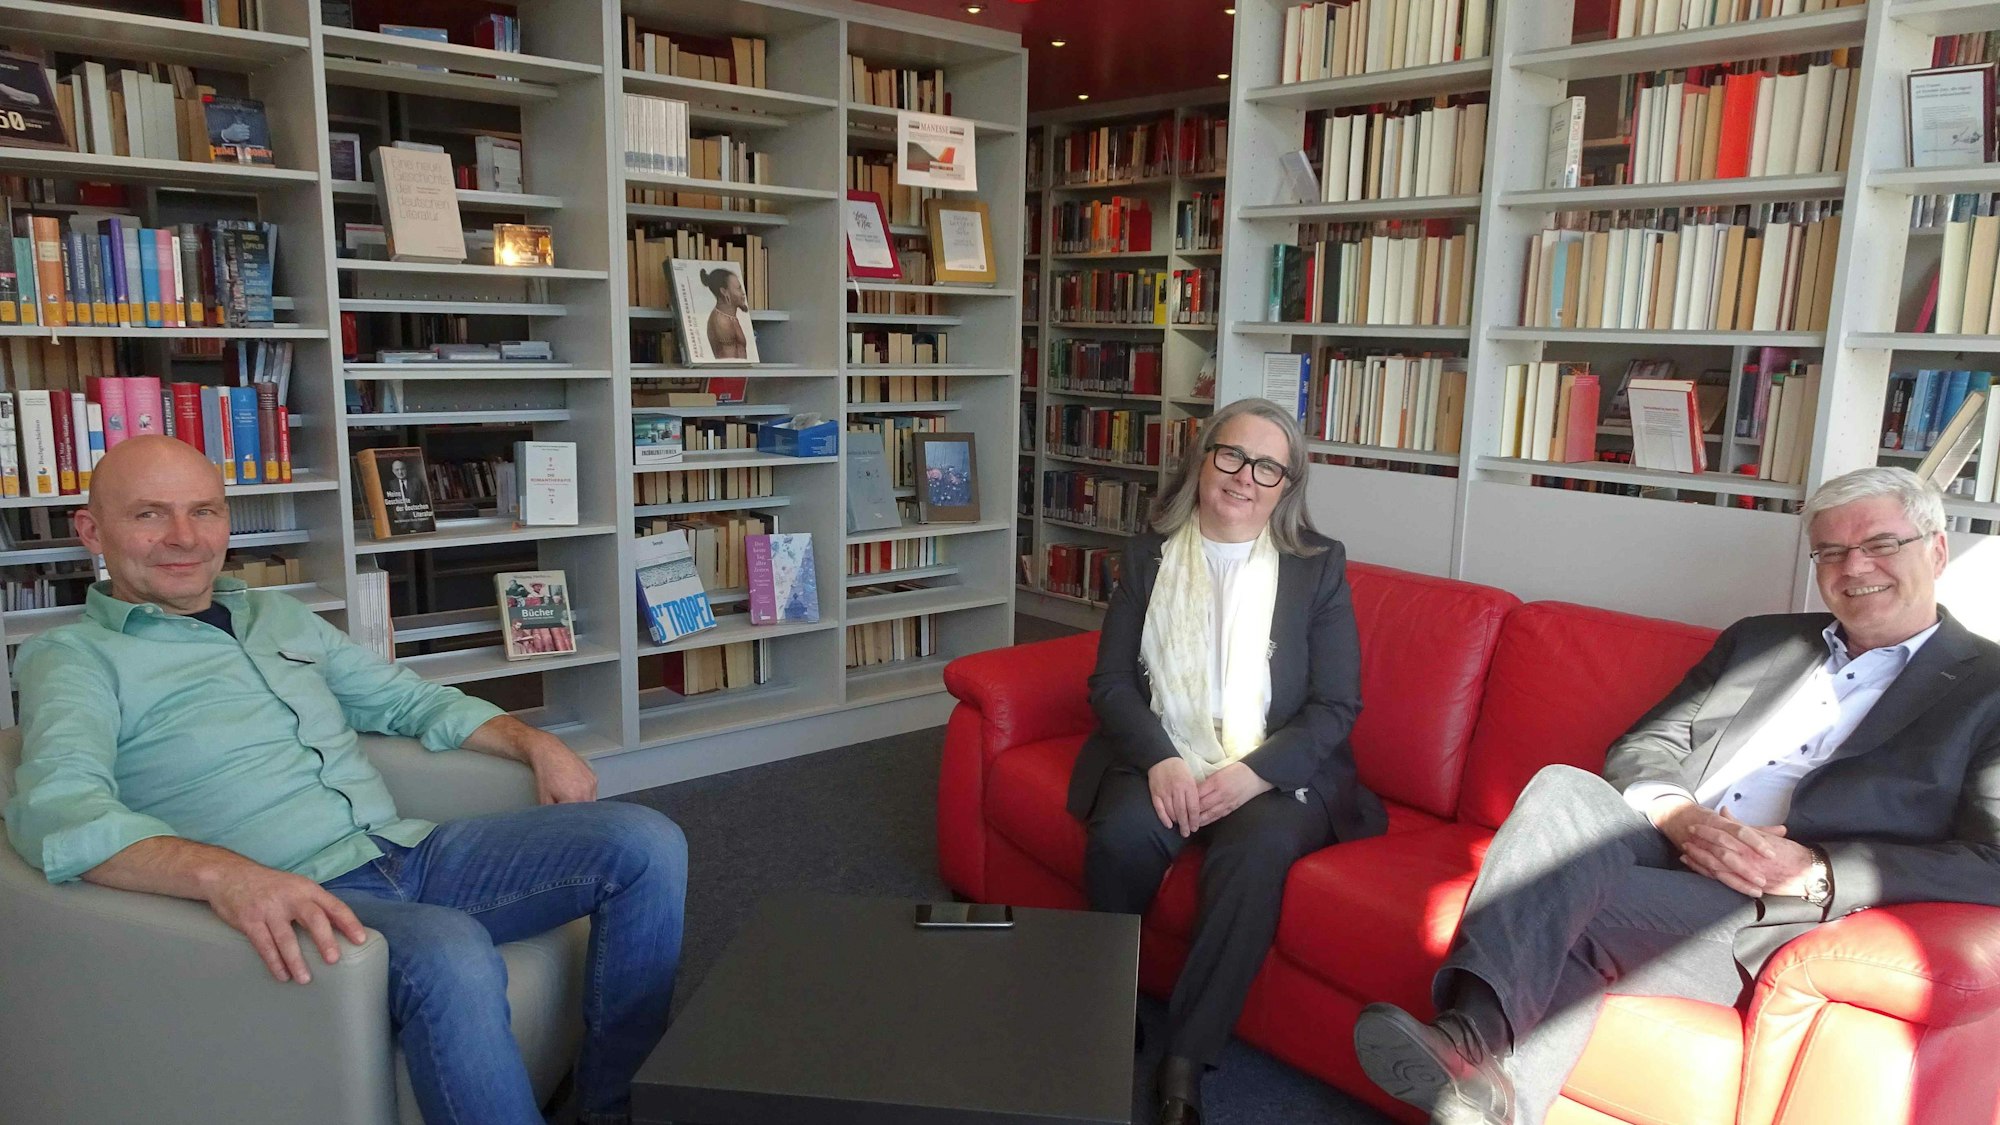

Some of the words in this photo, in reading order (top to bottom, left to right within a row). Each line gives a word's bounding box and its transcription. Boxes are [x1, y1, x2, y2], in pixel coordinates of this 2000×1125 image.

[920, 122, 949, 134] MANESSE
[521, 608, 555, 617] Bücher
[663, 591, 717, 637] TROPEZ
